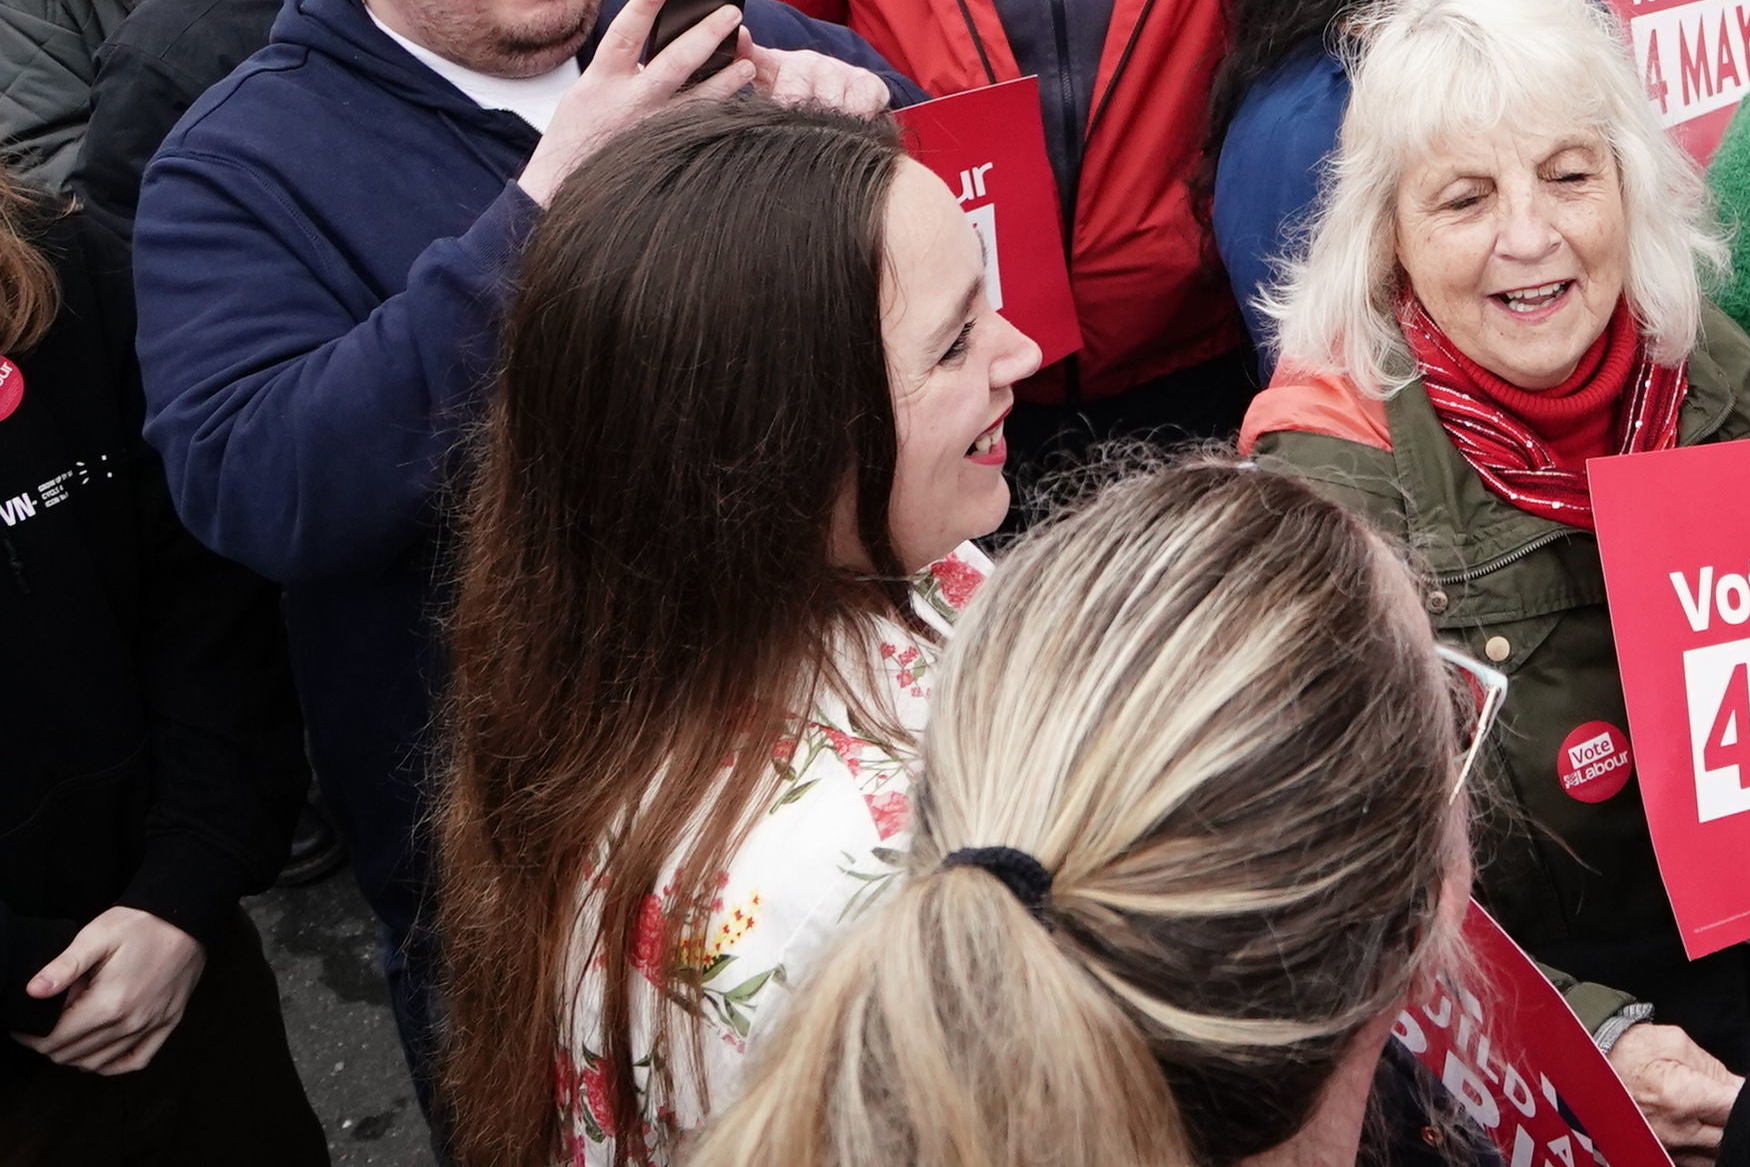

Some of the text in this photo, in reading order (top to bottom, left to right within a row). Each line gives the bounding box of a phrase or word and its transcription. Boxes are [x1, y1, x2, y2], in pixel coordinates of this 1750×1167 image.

[1646, 28, 1668, 115] 4
[1571, 739, 1611, 765] Vote
[1576, 750, 1629, 784] Labour
